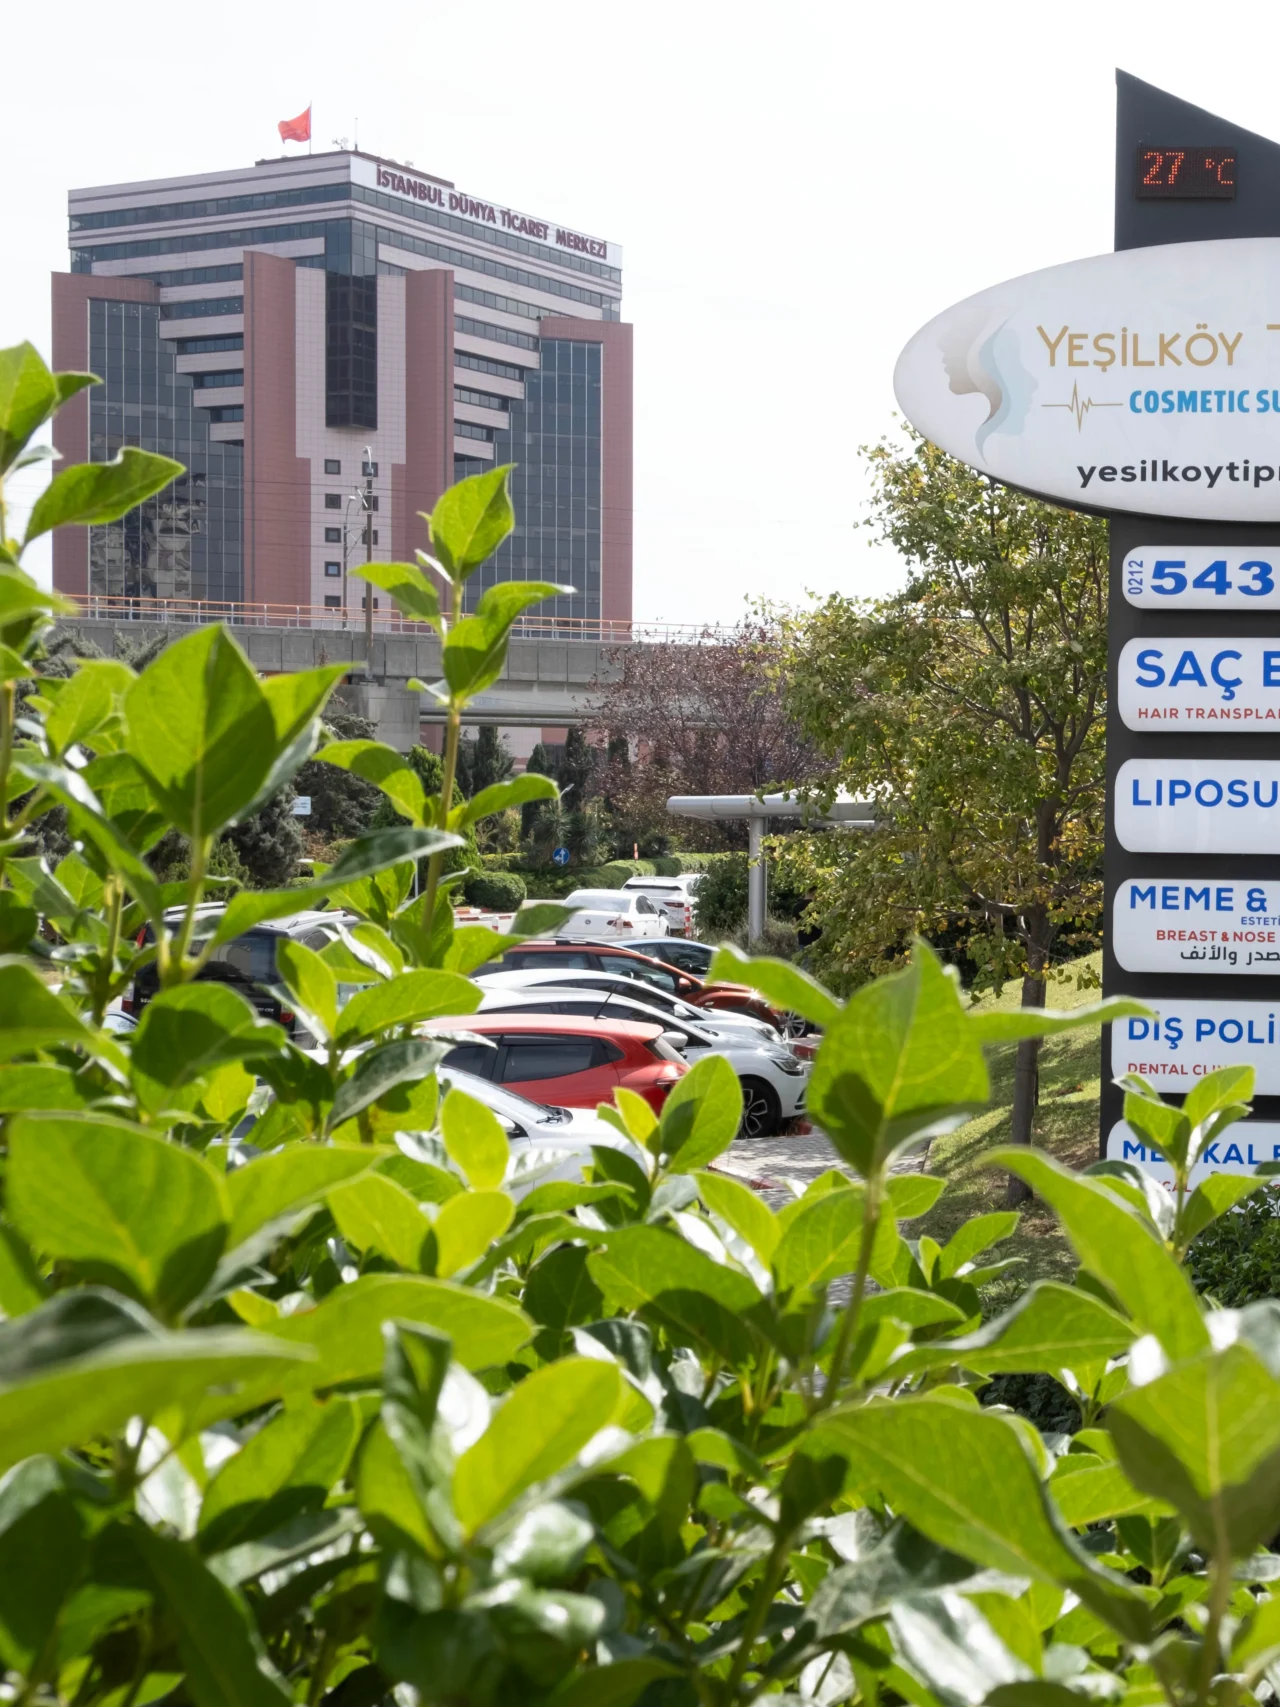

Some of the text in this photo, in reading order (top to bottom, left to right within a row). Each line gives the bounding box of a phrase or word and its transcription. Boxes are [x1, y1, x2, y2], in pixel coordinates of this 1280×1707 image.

[1143, 152, 1185, 185] 27
[376, 164, 608, 260] İSTANBUL DÜNYA TİCARET MERKEZİ
[1036, 323, 1243, 372] YEŞİLKÖY
[1129, 390, 1250, 414] COSMETIC
[1127, 559, 1144, 595] 0212
[1135, 649, 1243, 701] SAÇ
[1138, 708, 1179, 719] HAIR
[1130, 885, 1234, 912] MEME
[1245, 887, 1267, 913] &
[1156, 929, 1218, 942] BREAST
[1221, 931, 1230, 942] &
[1233, 931, 1276, 943] NOSE
[1180, 944, 1238, 966] والأنف
[1128, 1010, 1184, 1050] DİŞ
[1127, 1063, 1189, 1076] DENTAL
[1122, 1140, 1264, 1166] MEKAL
